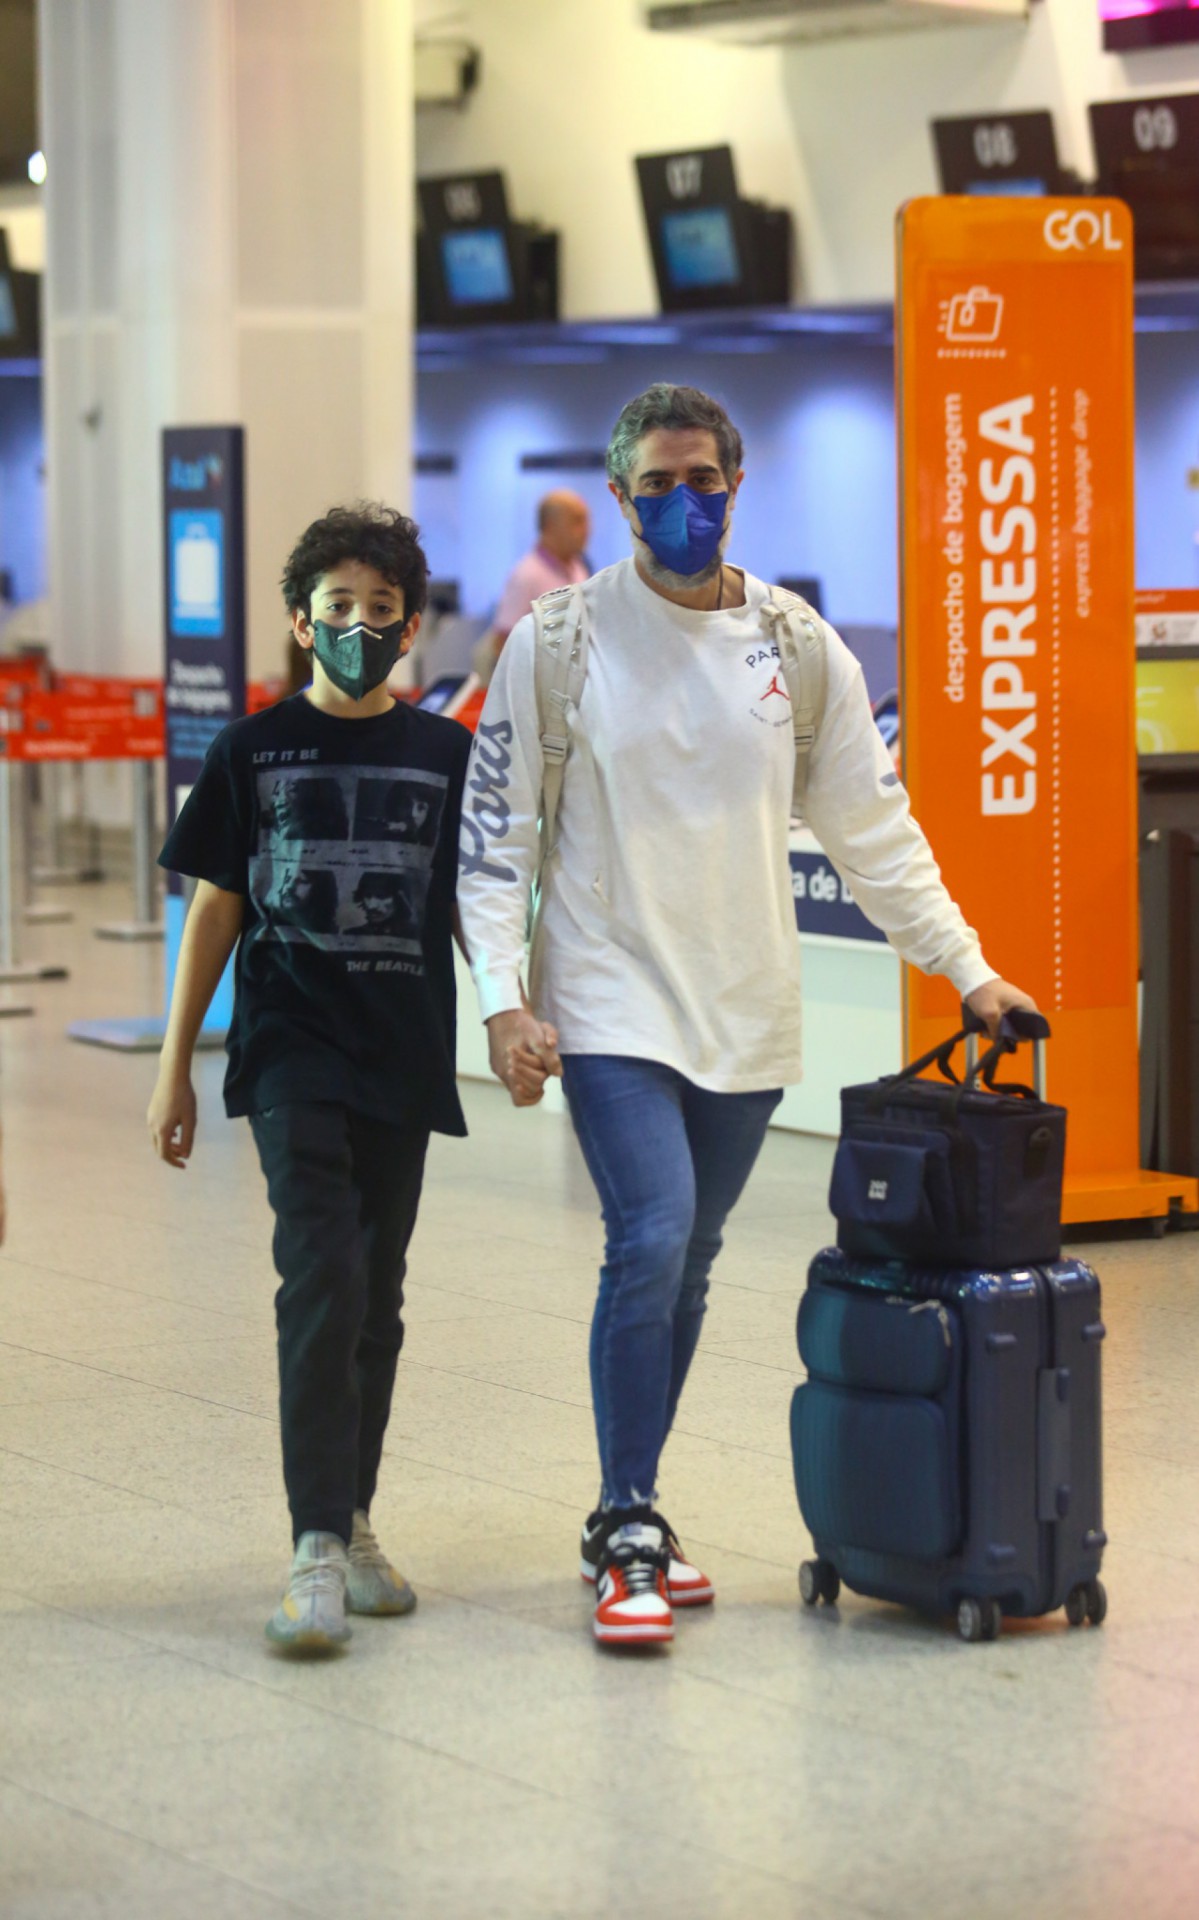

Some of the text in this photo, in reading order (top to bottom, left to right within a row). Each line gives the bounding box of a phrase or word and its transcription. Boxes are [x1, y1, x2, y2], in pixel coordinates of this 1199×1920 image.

[1133, 105, 1177, 151] 09
[1043, 209, 1122, 250] GOL
[943, 393, 967, 703] despacho de bagagem
[978, 395, 1037, 816] EXPRESSA
[253, 748, 320, 764] LET IT BE
[809, 866, 838, 901] de
[346, 961, 371, 972] THE
